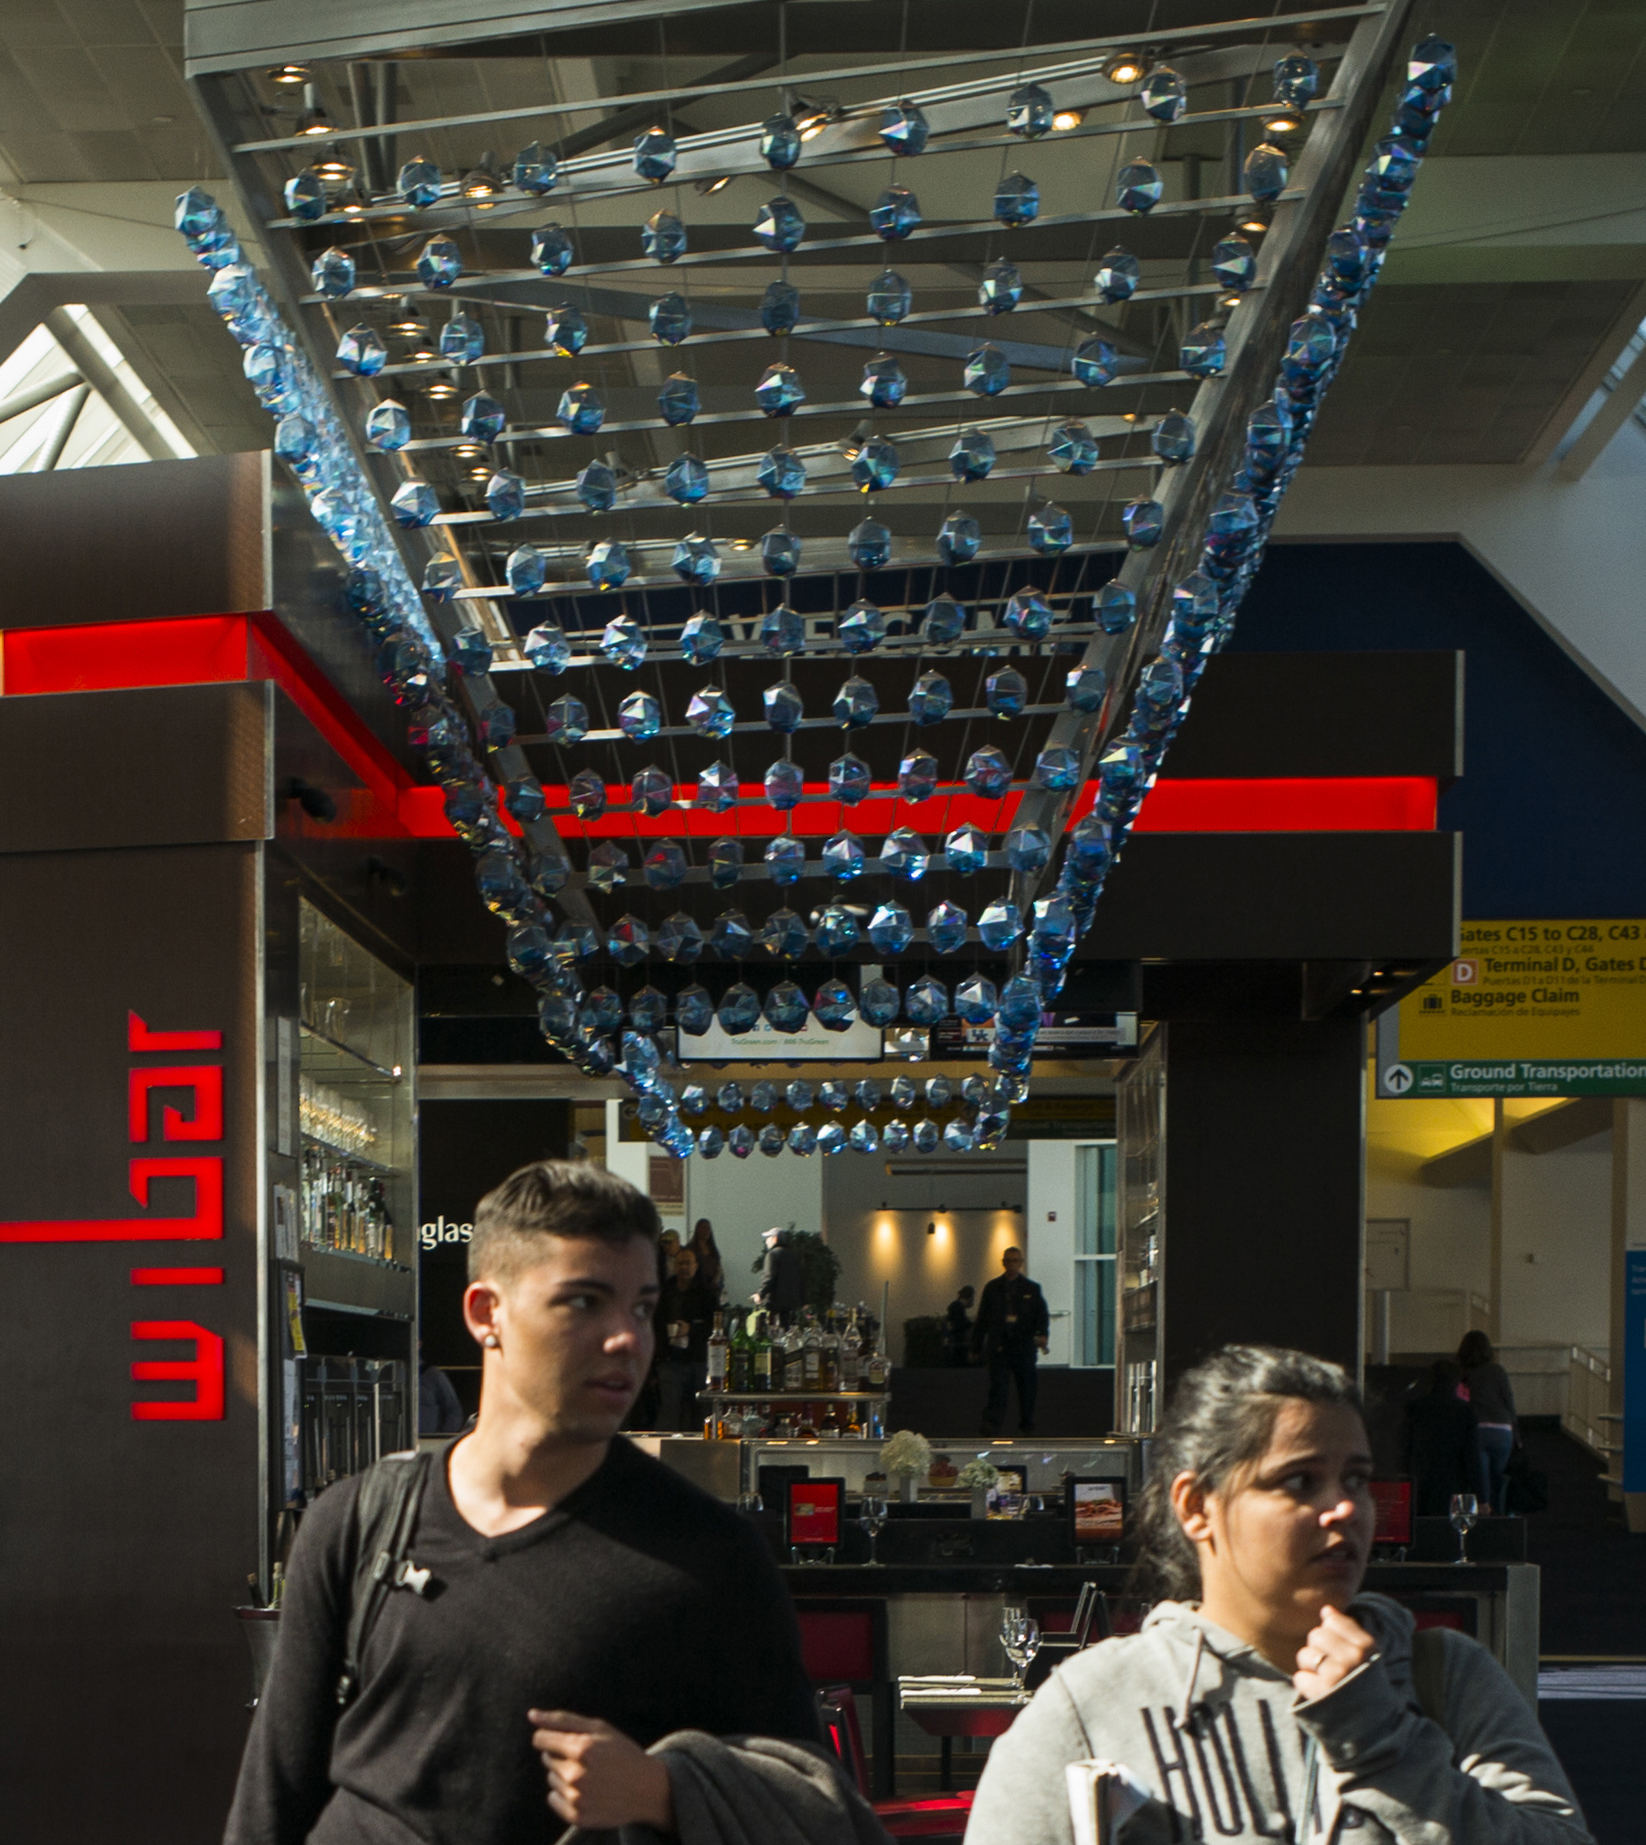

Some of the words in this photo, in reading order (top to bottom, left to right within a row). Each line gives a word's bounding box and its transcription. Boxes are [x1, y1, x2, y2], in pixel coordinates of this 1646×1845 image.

[1506, 927, 1538, 941] C15
[1543, 927, 1561, 941] to
[1566, 926, 1603, 942] C28,
[1608, 925, 1640, 940] C43
[1456, 963, 1473, 982] D
[1484, 957, 1558, 972] Terminal
[1562, 957, 1580, 973] D,
[1585, 956, 1635, 971] Gates
[1451, 989, 1526, 1007] Baggage
[1531, 988, 1580, 1003] Claim
[1449, 1063, 1516, 1079] Ground
